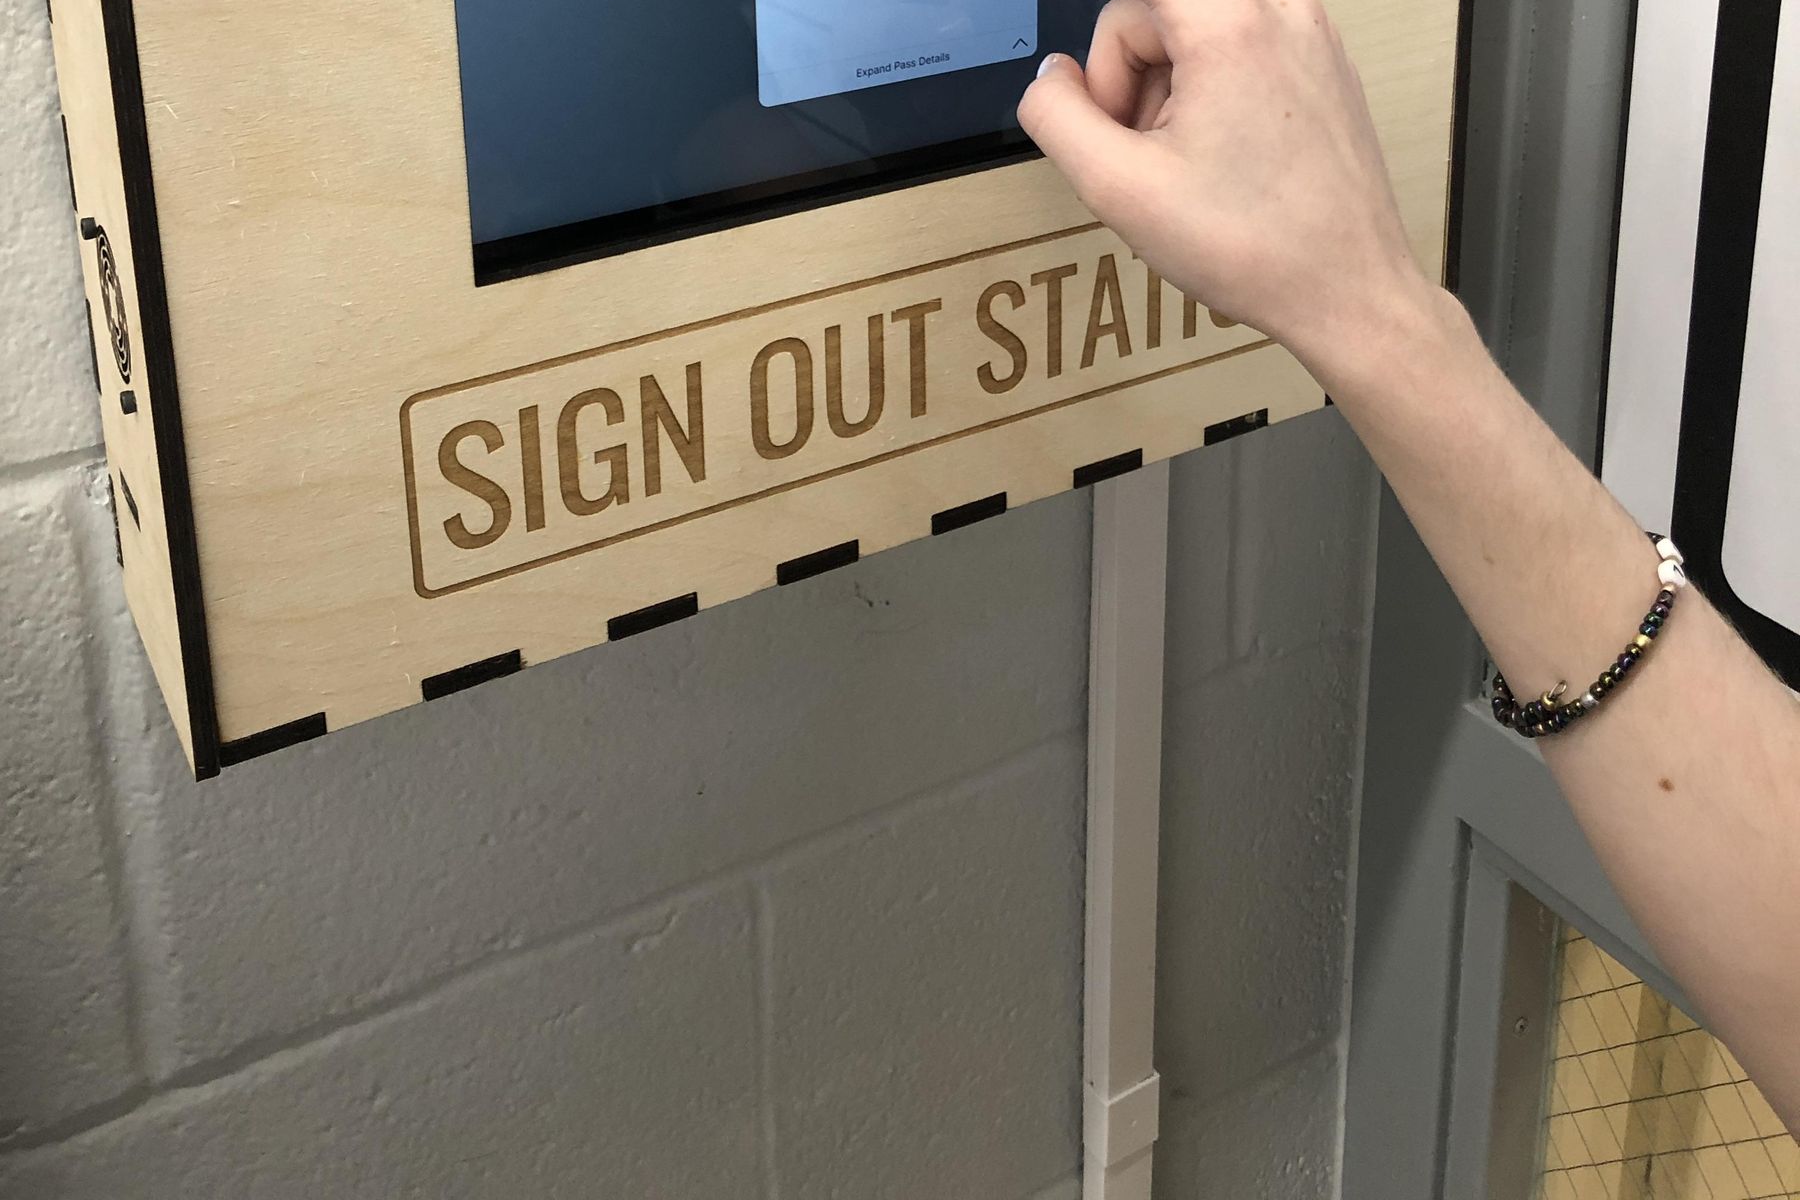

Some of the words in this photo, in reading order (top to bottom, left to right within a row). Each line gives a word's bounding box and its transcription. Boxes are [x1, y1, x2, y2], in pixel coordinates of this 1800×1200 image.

[856, 62, 892, 80] Expand
[895, 59, 915, 73] Pass
[918, 52, 950, 67] Details
[436, 360, 706, 552] SIGN
[747, 297, 943, 460] OUT
[975, 251, 1240, 395] STAT
